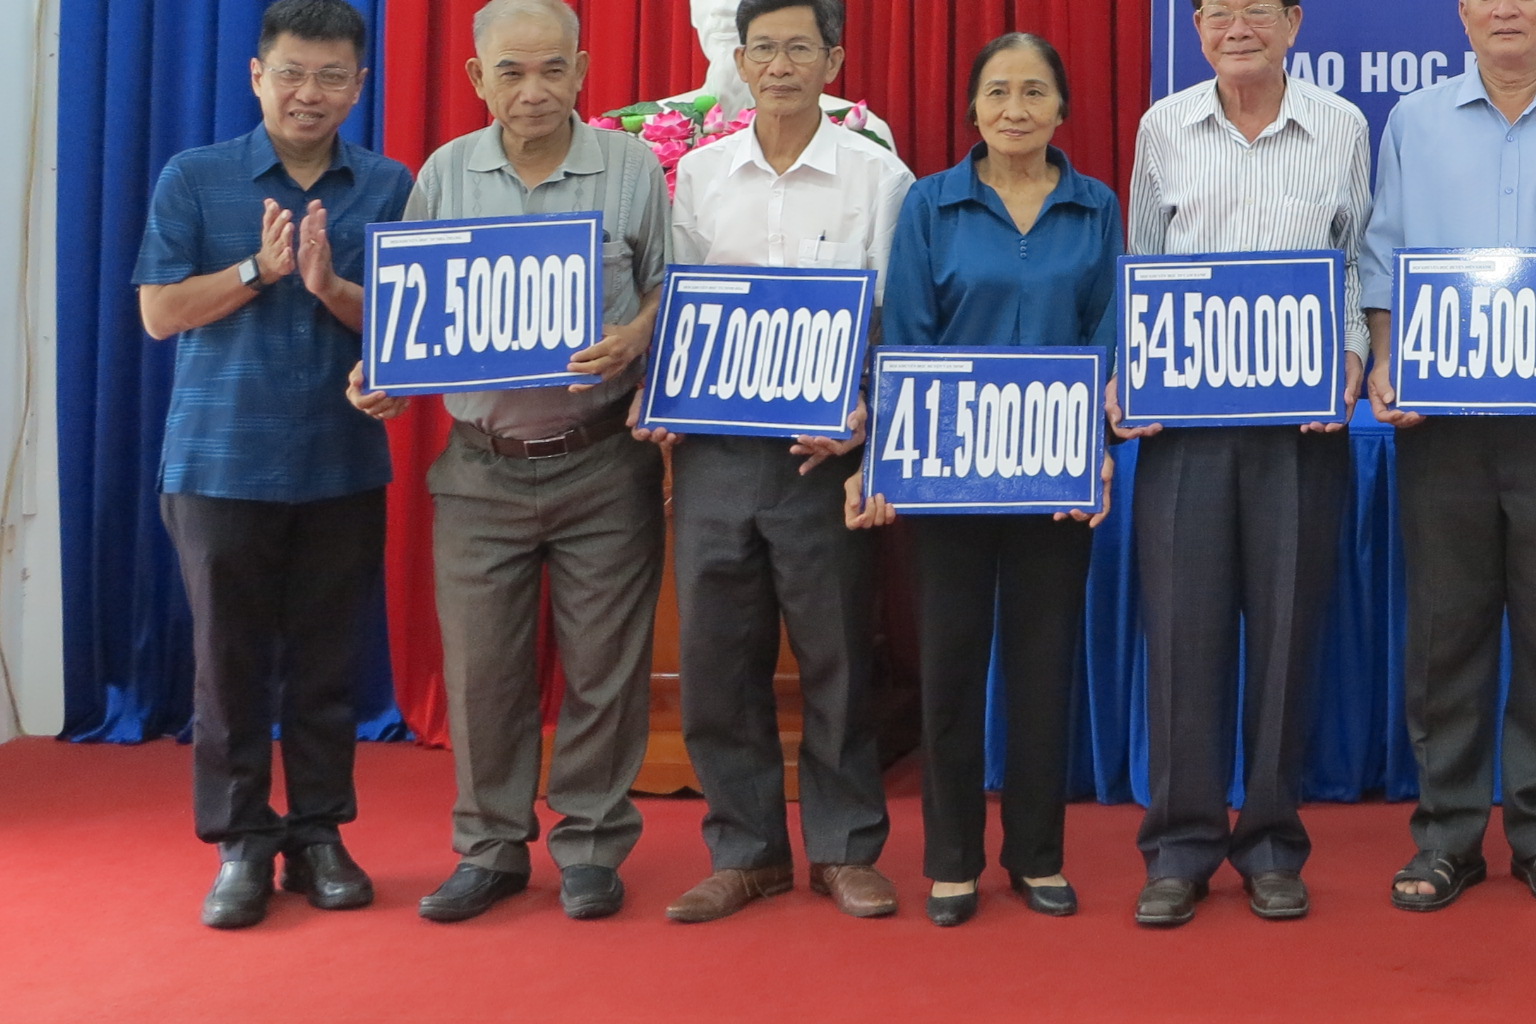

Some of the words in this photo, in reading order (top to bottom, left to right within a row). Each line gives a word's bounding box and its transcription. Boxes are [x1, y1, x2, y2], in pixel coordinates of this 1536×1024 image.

[379, 254, 586, 364] 72.500.000
[665, 303, 852, 403] 87.000.000
[1131, 292, 1323, 390] 54.500.000
[882, 377, 1089, 479] 41.500.000
